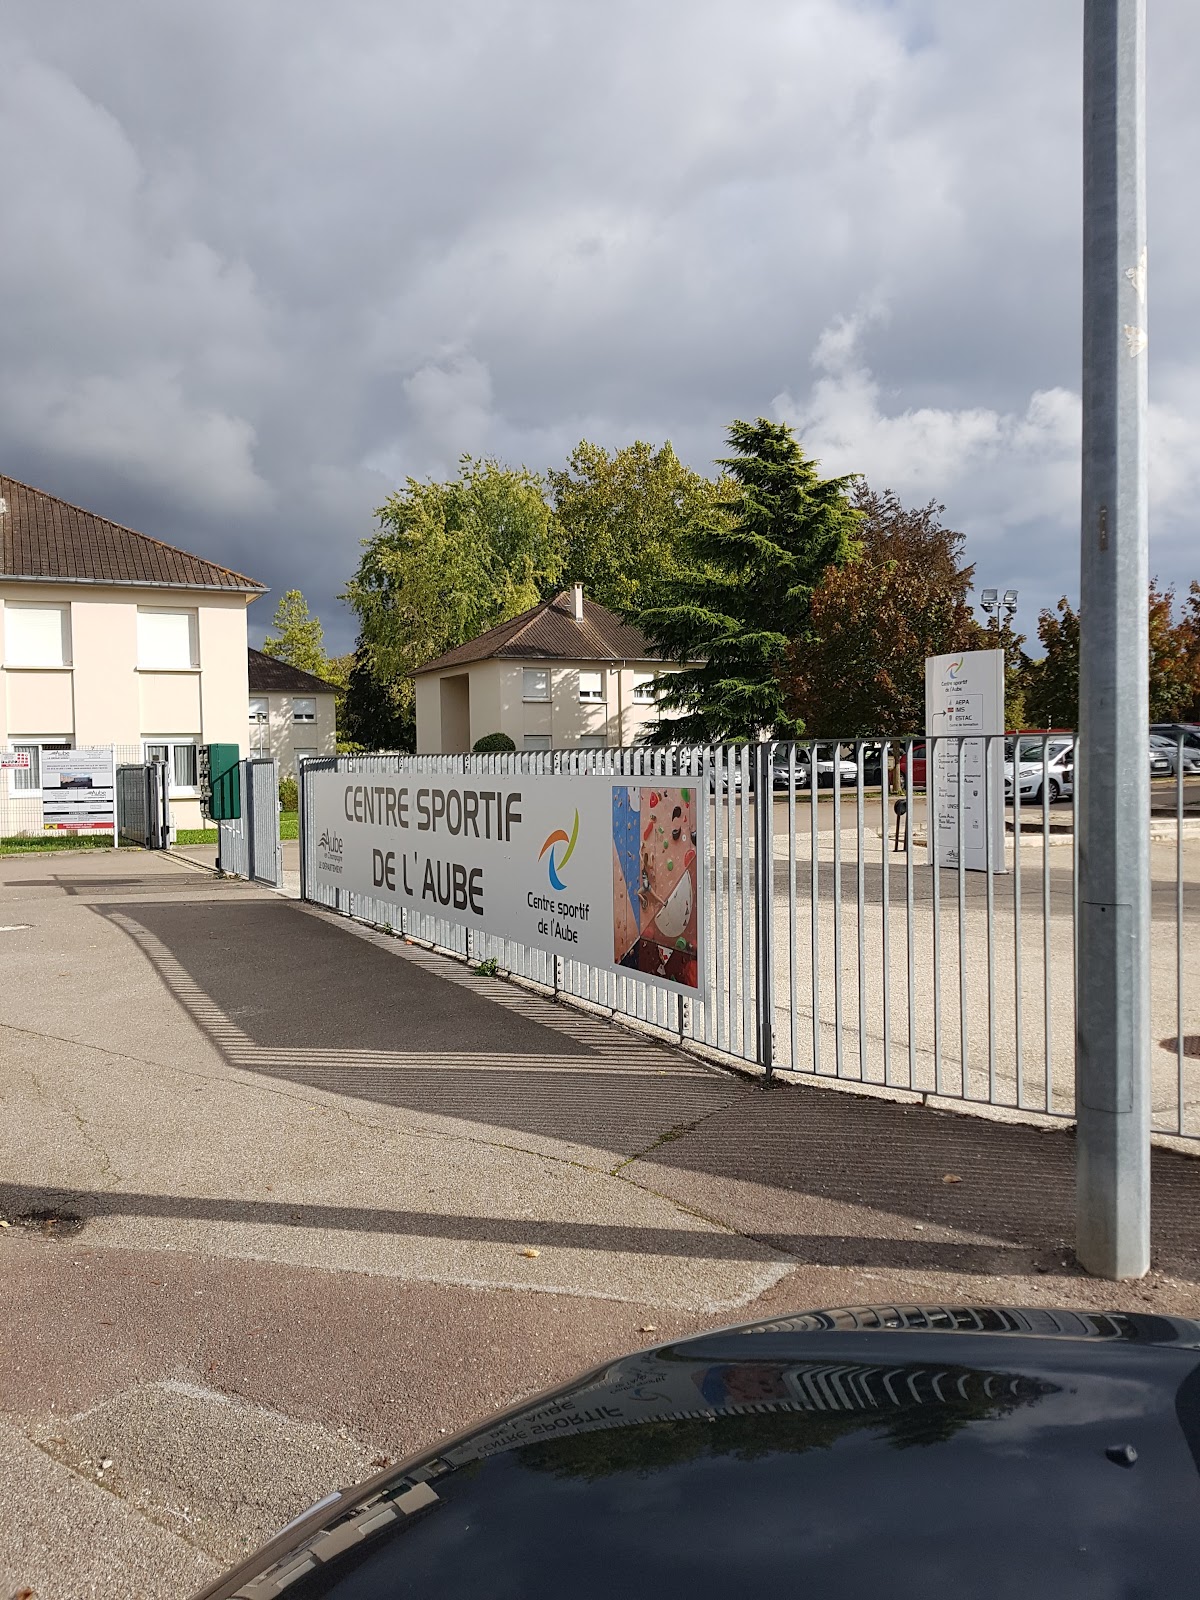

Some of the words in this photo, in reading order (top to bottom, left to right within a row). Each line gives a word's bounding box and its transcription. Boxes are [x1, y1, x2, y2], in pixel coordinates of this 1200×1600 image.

[344, 785, 409, 829] CENTRE
[416, 788, 522, 842] SPORTIF
[318, 828, 343, 854] Aube
[372, 848, 396, 892] DE
[402, 851, 484, 916] L'AUBE
[527, 891, 555, 912] Centre
[557, 902, 590, 921] sportif
[537, 918, 549, 935] de
[550, 919, 579, 944] l'Aube
